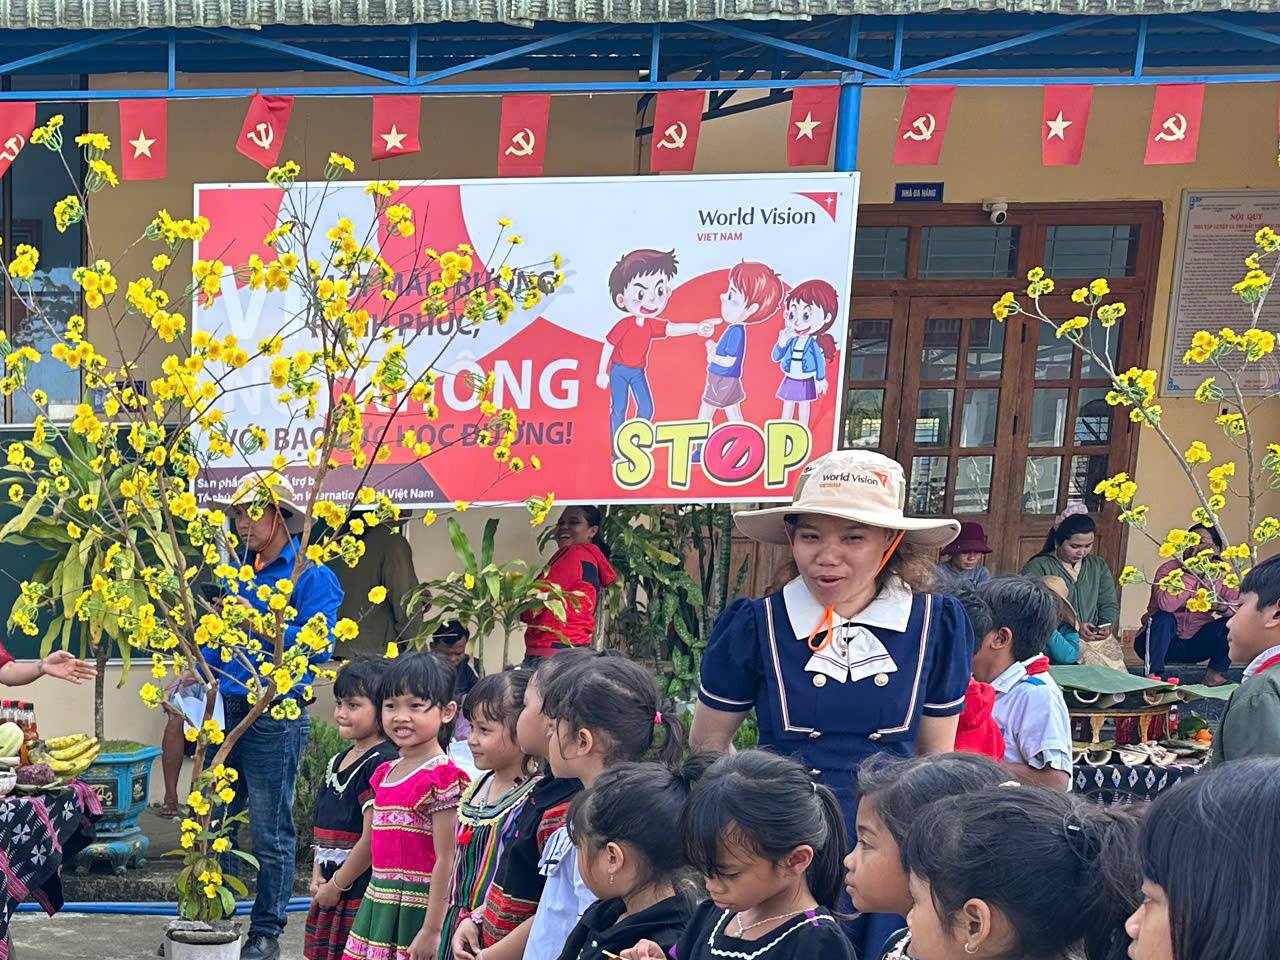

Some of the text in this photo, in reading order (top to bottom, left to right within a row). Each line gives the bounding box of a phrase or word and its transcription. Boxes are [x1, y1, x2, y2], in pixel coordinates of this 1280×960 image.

[698, 207, 816, 226] World Vision
[697, 232, 743, 242] VIET NAM
[616, 421, 810, 487] STOP
[409, 489, 434, 498] Nam
